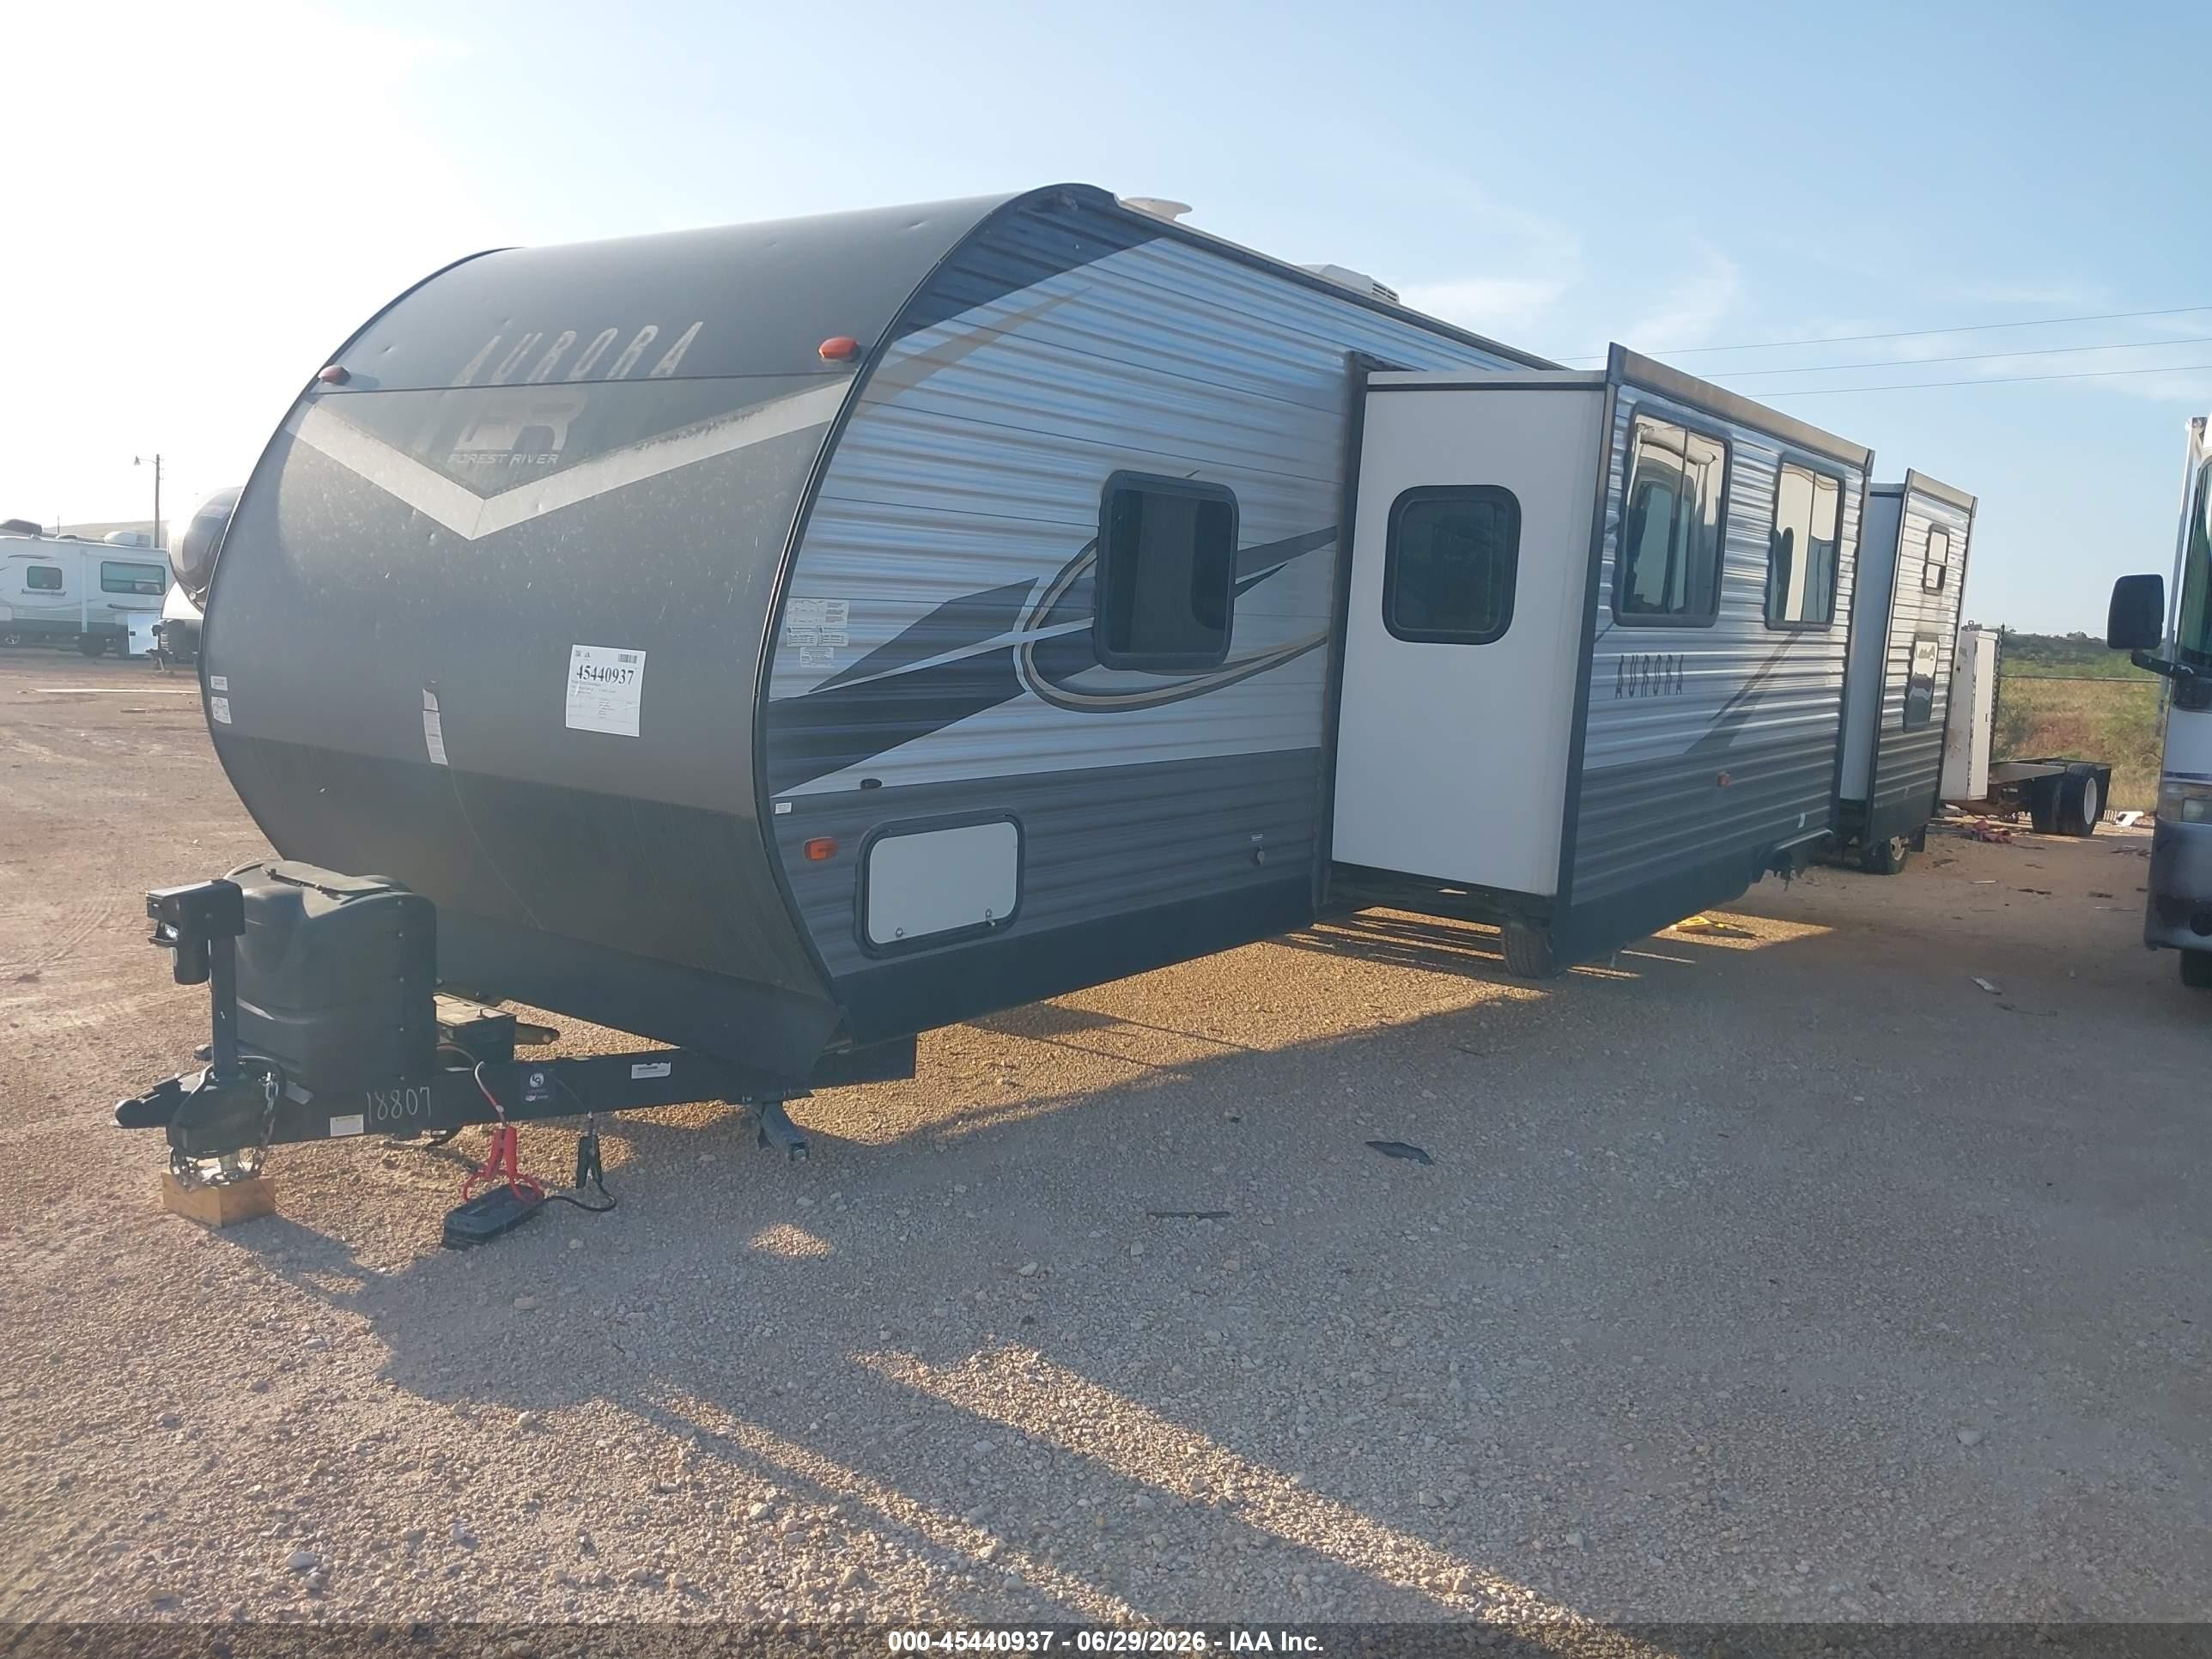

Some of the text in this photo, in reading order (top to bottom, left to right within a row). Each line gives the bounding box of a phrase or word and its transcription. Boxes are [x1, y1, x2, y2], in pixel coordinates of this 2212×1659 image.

[452, 320, 704, 386] AURORA
[447, 453, 559, 467] FOREST RIVER
[576, 665, 635, 685] 45440937
[1614, 653, 1684, 700] AURORA
[366, 1086, 431, 1125] 18807
